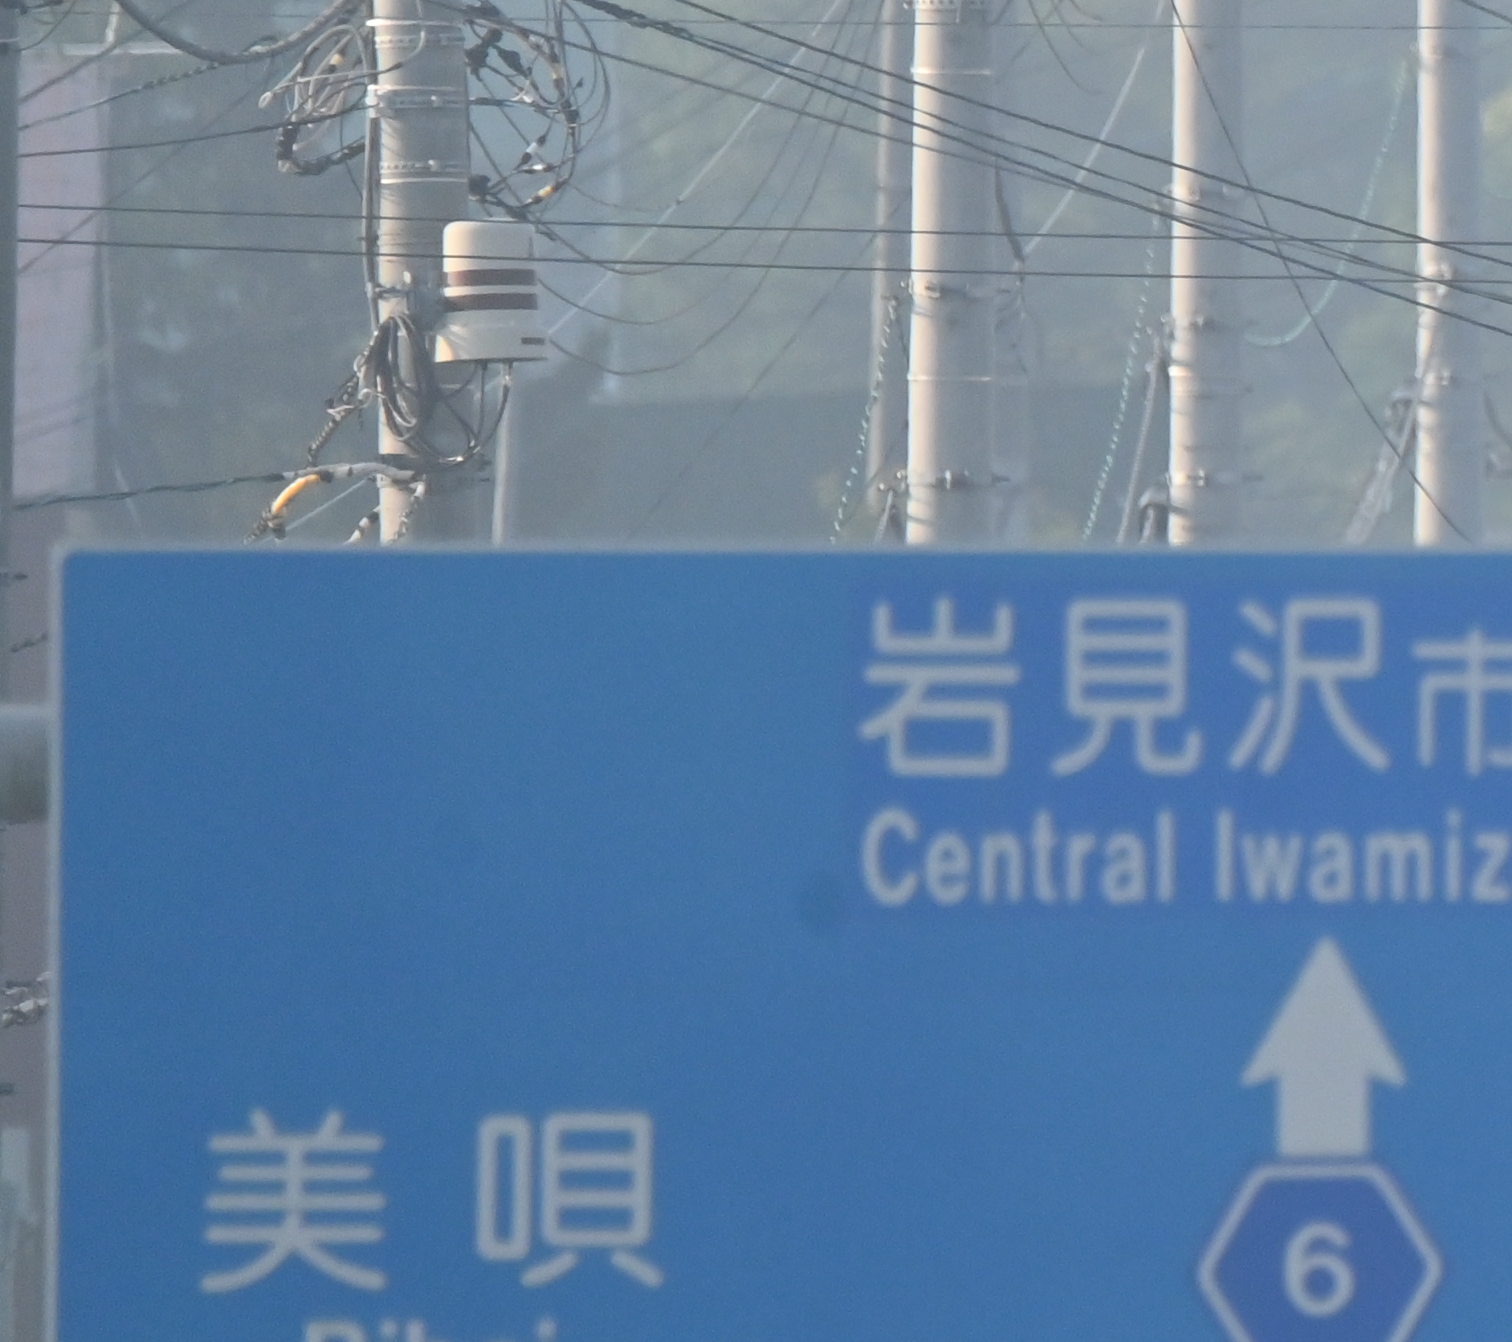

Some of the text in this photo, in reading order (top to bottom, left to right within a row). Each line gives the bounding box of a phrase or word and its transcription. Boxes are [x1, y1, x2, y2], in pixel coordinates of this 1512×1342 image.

[860, 808, 1175, 907] Central
[198, 1107, 666, 1295] 美唄
[1281, 1221, 1356, 1319] 6
